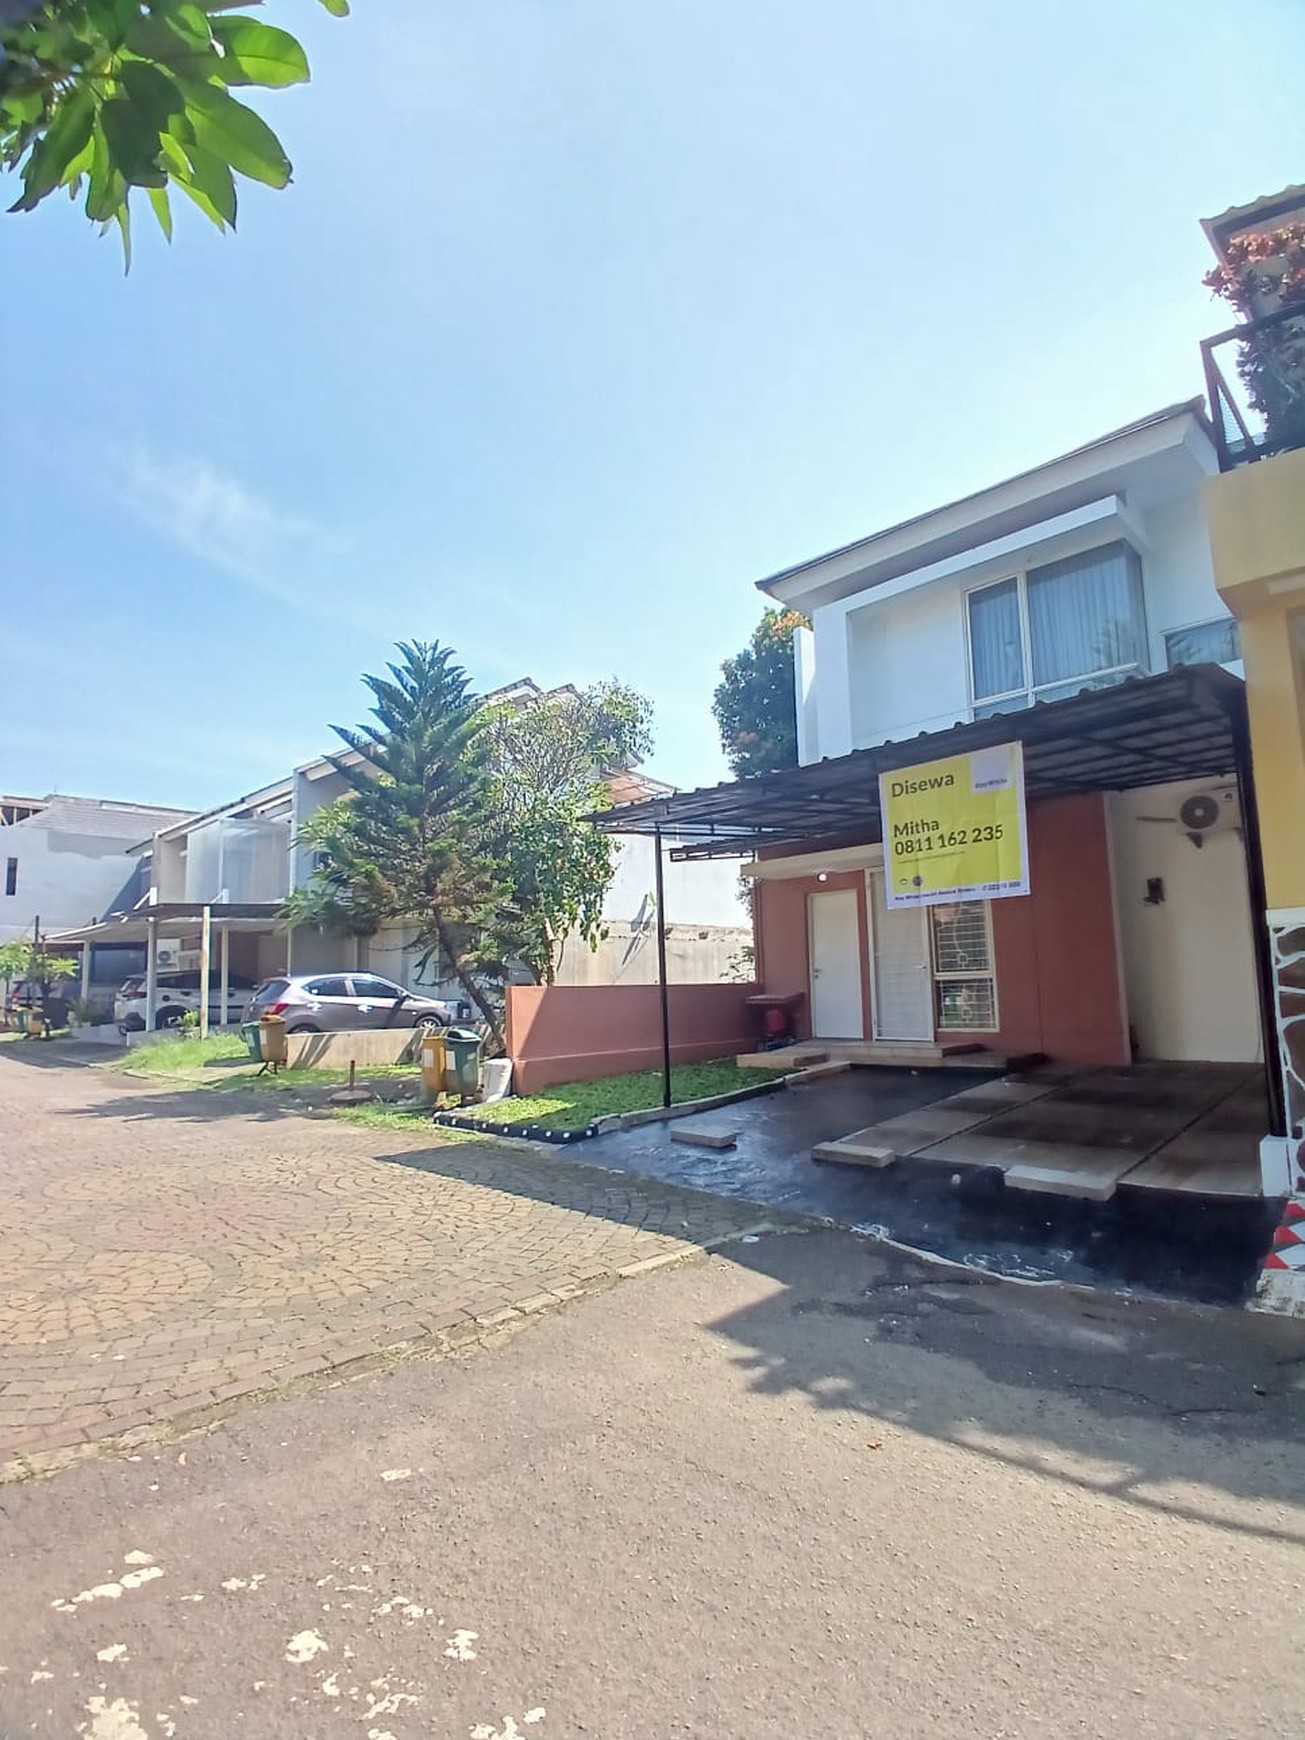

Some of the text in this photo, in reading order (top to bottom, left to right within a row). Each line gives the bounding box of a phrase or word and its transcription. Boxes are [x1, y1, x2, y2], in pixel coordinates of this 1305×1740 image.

[891, 773, 955, 797] Disewa
[893, 819, 940, 837] Mitha
[895, 824, 1003, 856] 0811 162 235
